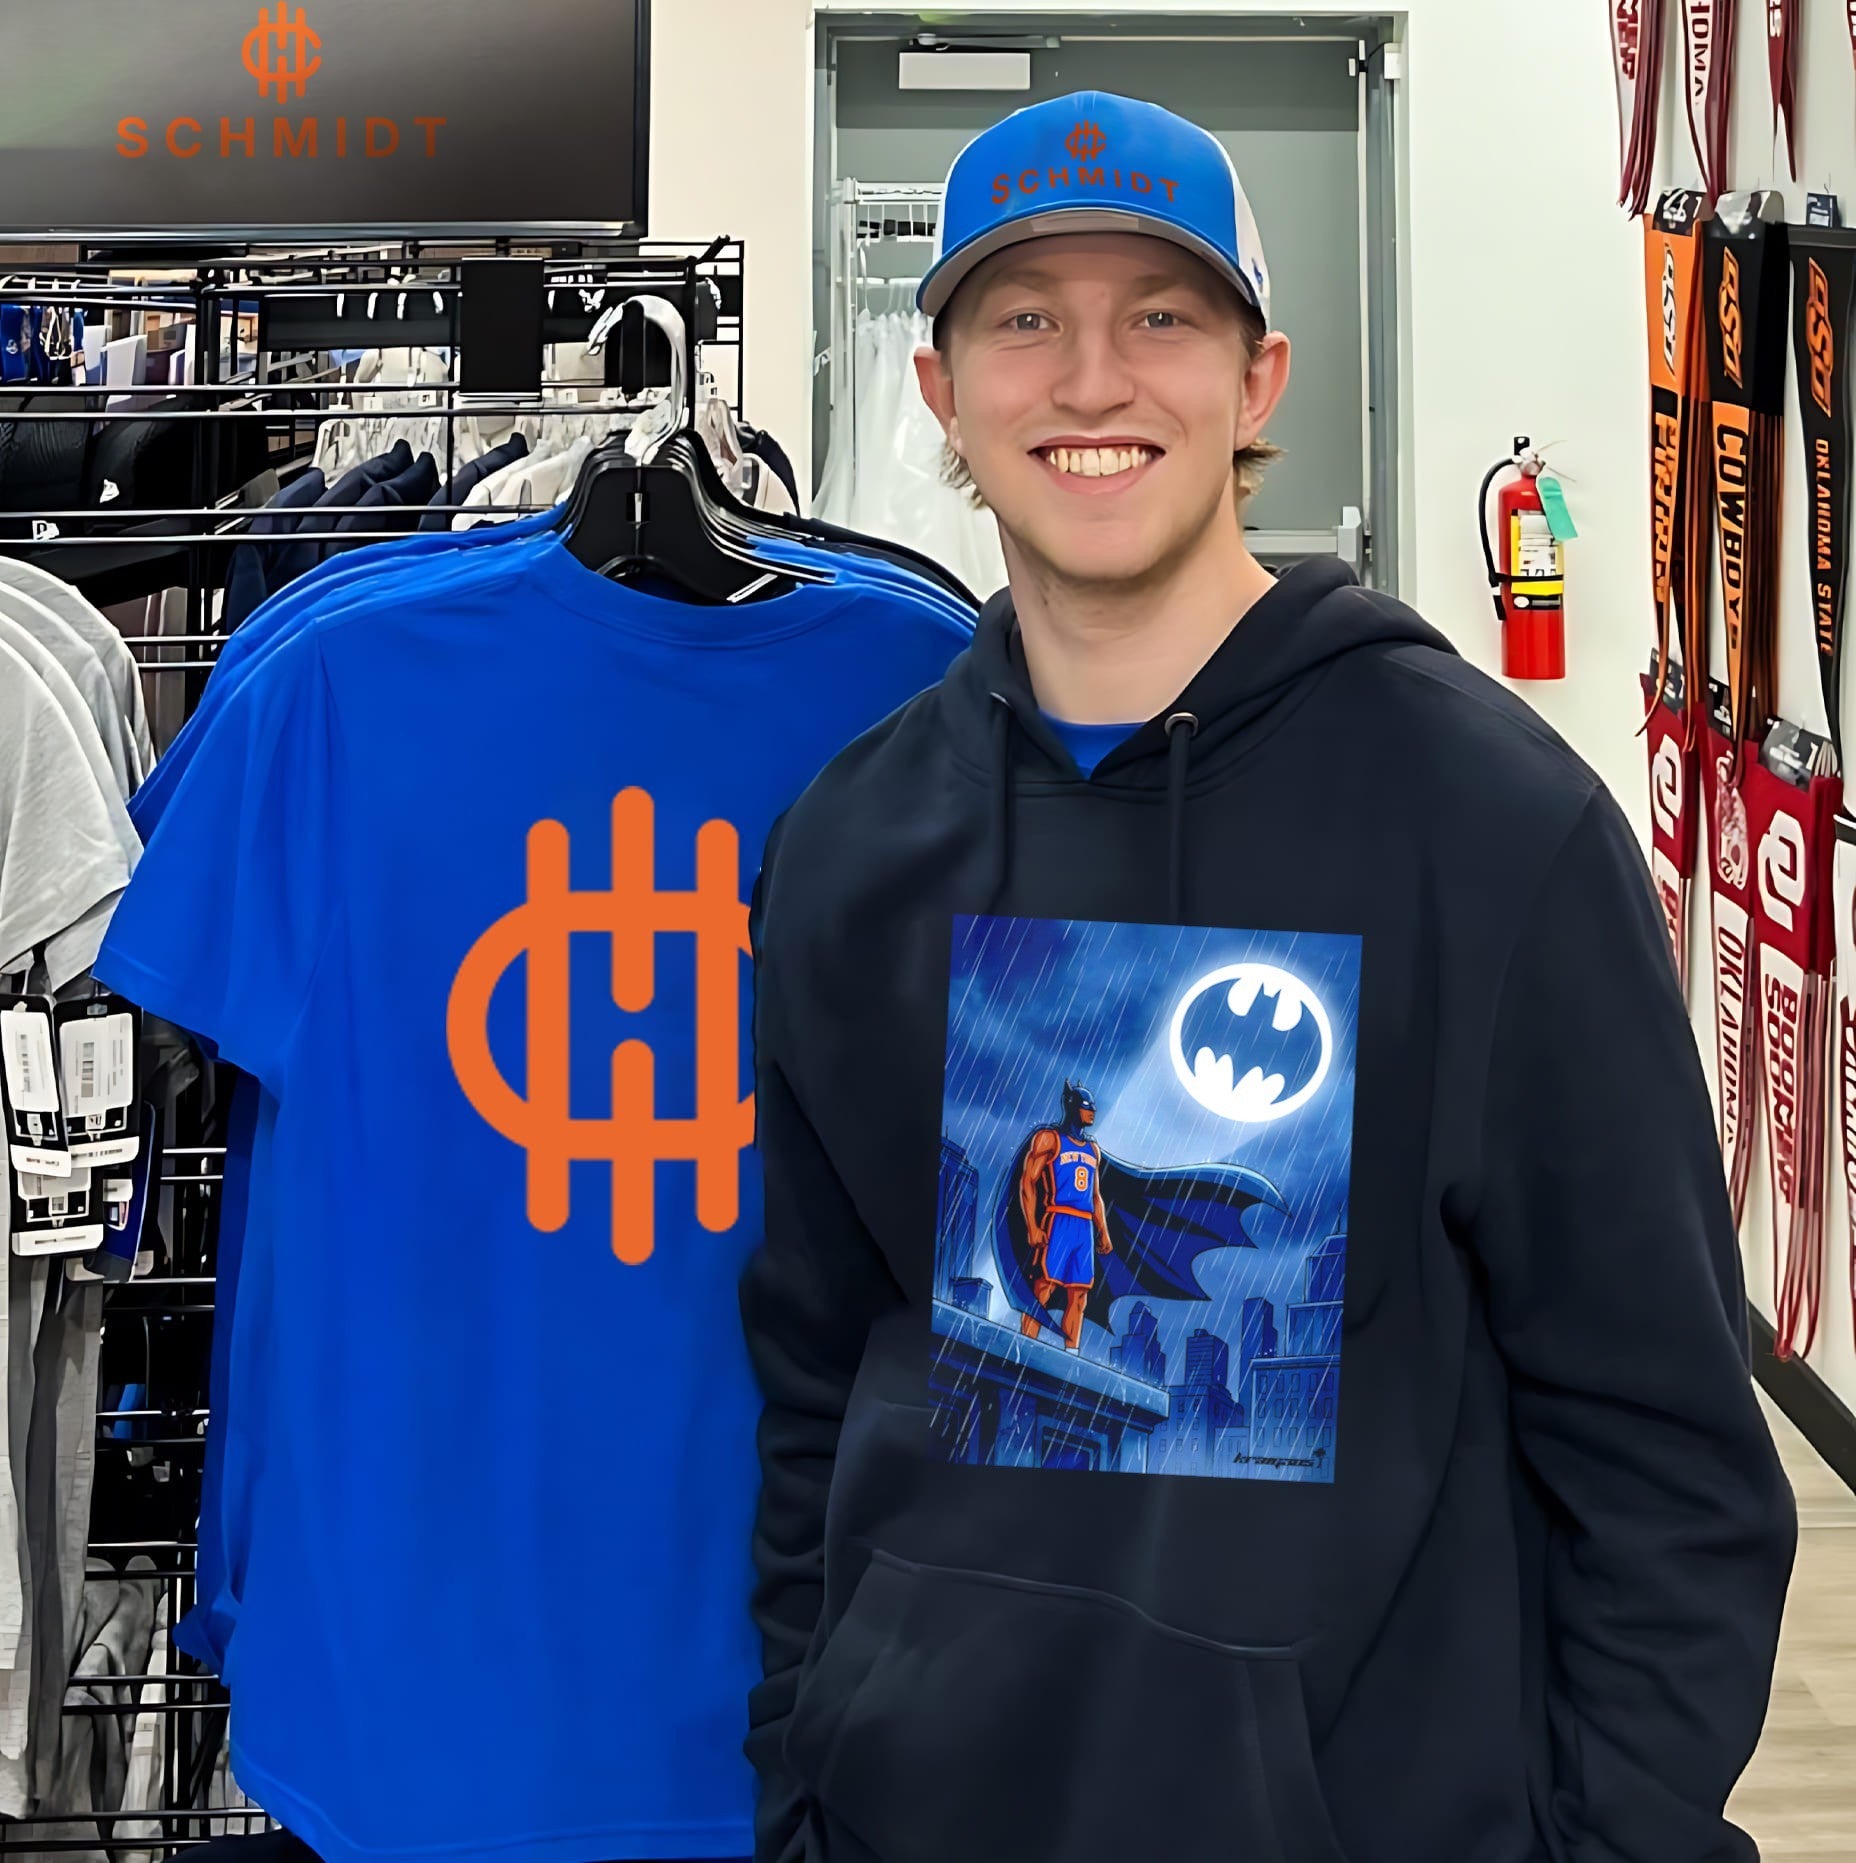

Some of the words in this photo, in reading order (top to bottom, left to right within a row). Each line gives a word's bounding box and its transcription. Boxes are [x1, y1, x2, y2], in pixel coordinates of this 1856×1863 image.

[115, 116, 447, 159] SCHMIDT
[991, 166, 1179, 204] SCHMIDT
[1074, 1165, 1089, 1192] 8
